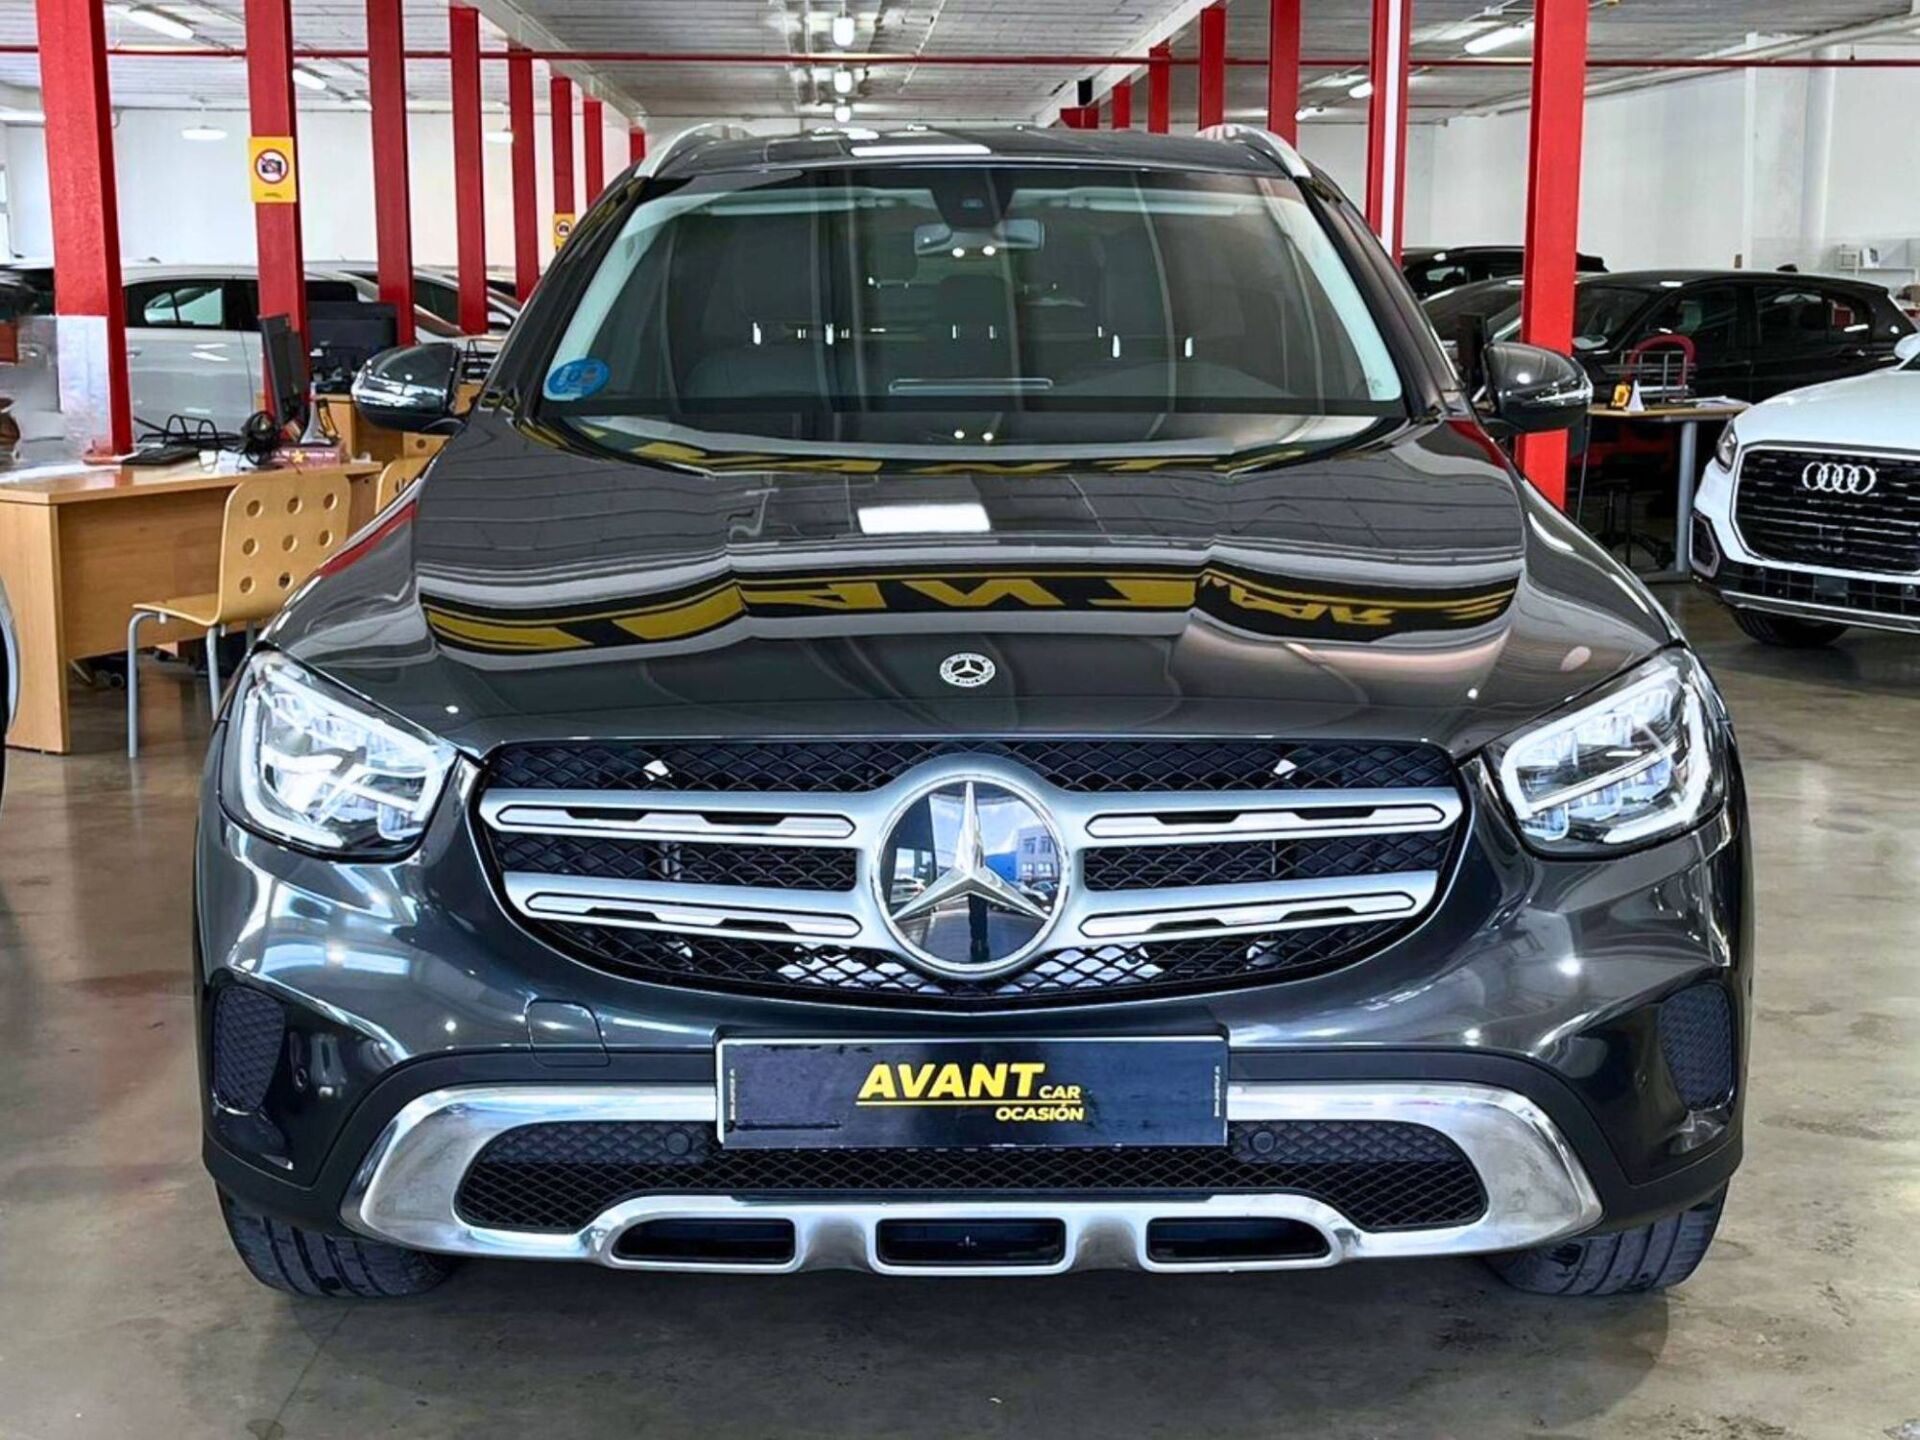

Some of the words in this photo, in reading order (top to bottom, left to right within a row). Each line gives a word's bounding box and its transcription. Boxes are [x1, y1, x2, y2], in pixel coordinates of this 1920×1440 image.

[857, 1063, 1045, 1099] AVANT
[1039, 1085, 1081, 1099] CAR
[995, 1104, 1084, 1121] OCASIÓN
